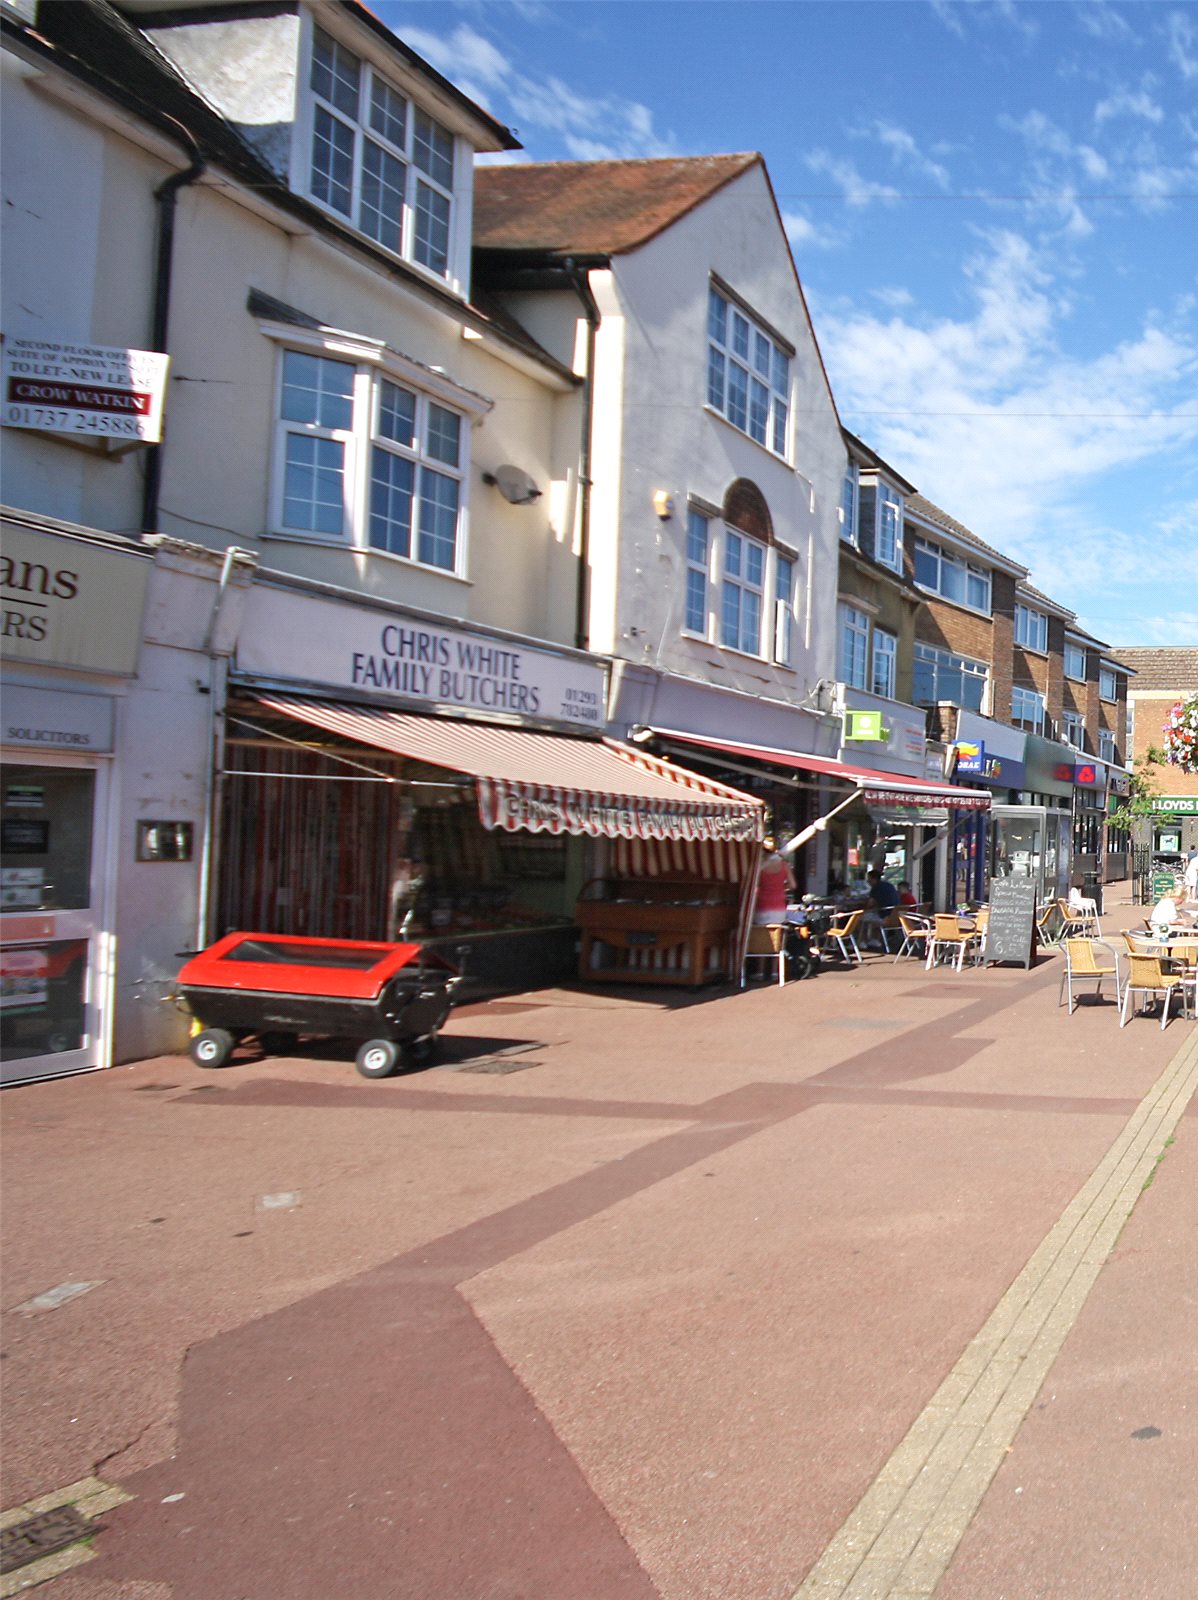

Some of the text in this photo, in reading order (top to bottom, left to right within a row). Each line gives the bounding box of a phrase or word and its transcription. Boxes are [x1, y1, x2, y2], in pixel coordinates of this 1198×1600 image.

[7, 349, 39, 360] SUITE
[42, 353, 56, 361] OF
[61, 355, 106, 368] APPROX
[15, 340, 61, 351] SECOND
[64, 344, 103, 356] FLOOR
[10, 361, 31, 373] TO
[70, 368, 103, 380] NEW
[107, 373, 153, 388] LEASE
[16, 384, 145, 410] CROW WATKIN
[9, 406, 145, 435] 01737 245886
[381, 625, 522, 681] CHRIS WHITE
[351, 652, 541, 713] FAMILY BUTCHERS
[565, 687, 597, 705] 01293
[8, 727, 90, 745] SOLICITORS
[505, 792, 563, 822] CHRIS
[572, 804, 632, 829] WHITE
[638, 811, 685, 832] FAMILY
[1152, 799, 1194, 811] LLOYDS
